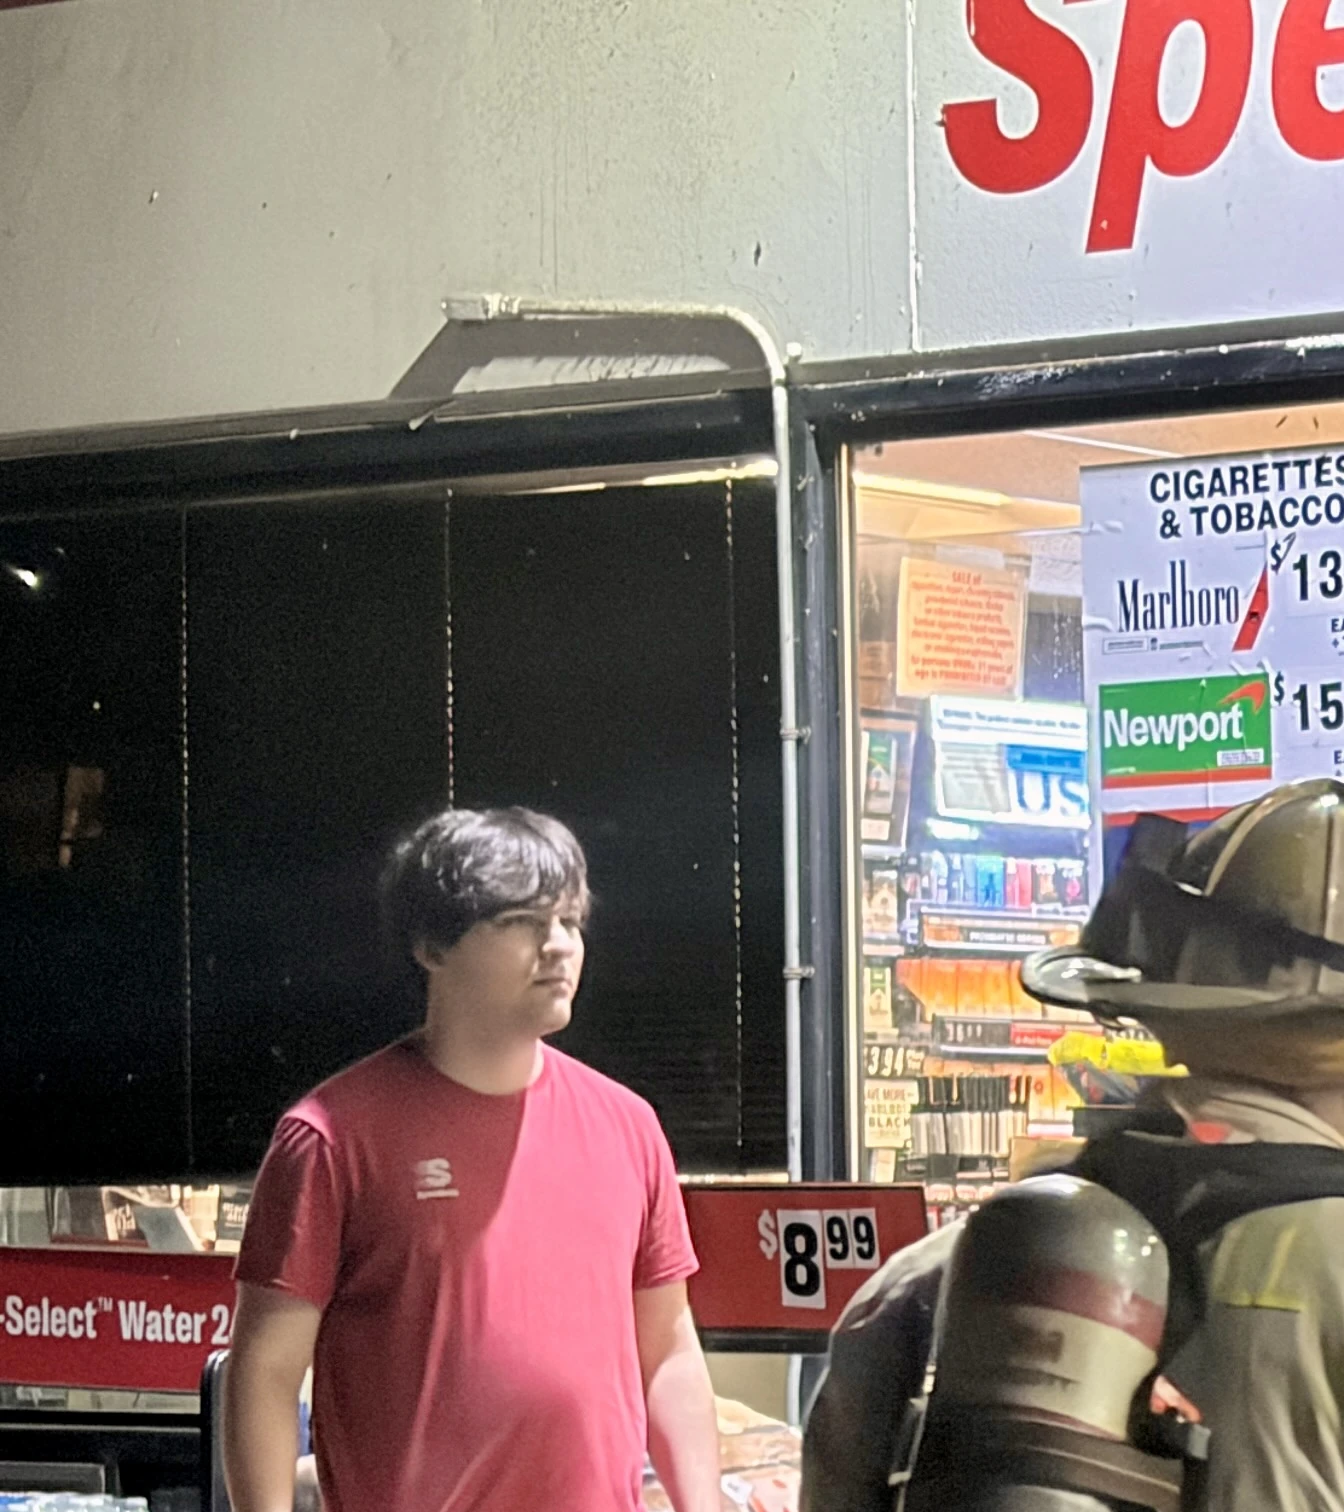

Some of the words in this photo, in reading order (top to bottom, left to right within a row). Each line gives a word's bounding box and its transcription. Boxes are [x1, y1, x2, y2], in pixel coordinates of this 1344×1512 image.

[1160, 508, 1182, 539] &
[1117, 560, 1239, 633] Marlboro
[1103, 702, 1244, 752] Newport
[118, 1300, 206, 1344] Water
[211, 1304, 230, 1345] 2
